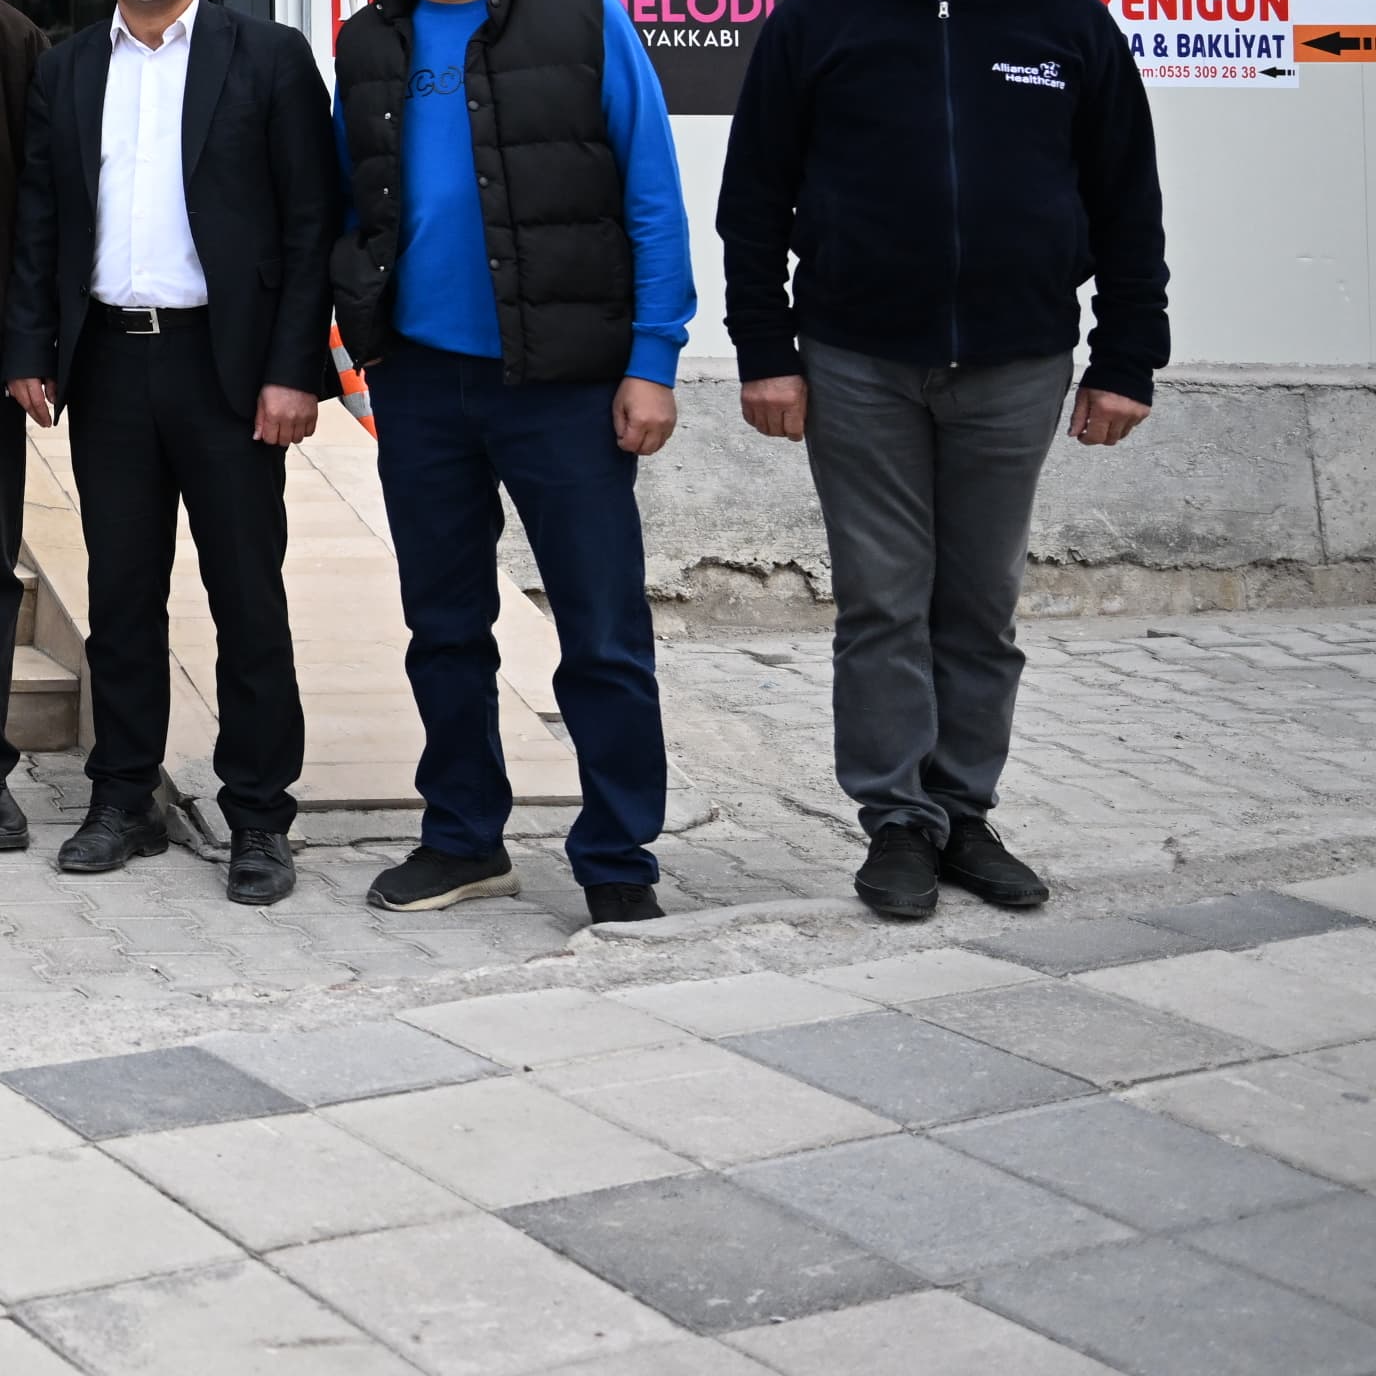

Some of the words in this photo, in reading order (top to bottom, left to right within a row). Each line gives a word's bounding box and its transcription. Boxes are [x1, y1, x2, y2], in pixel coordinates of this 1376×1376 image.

[1176, 27, 1285, 59] BAKLİYAT
[992, 62, 1039, 75] Alliance
[1005, 73, 1066, 90] Healthcare
